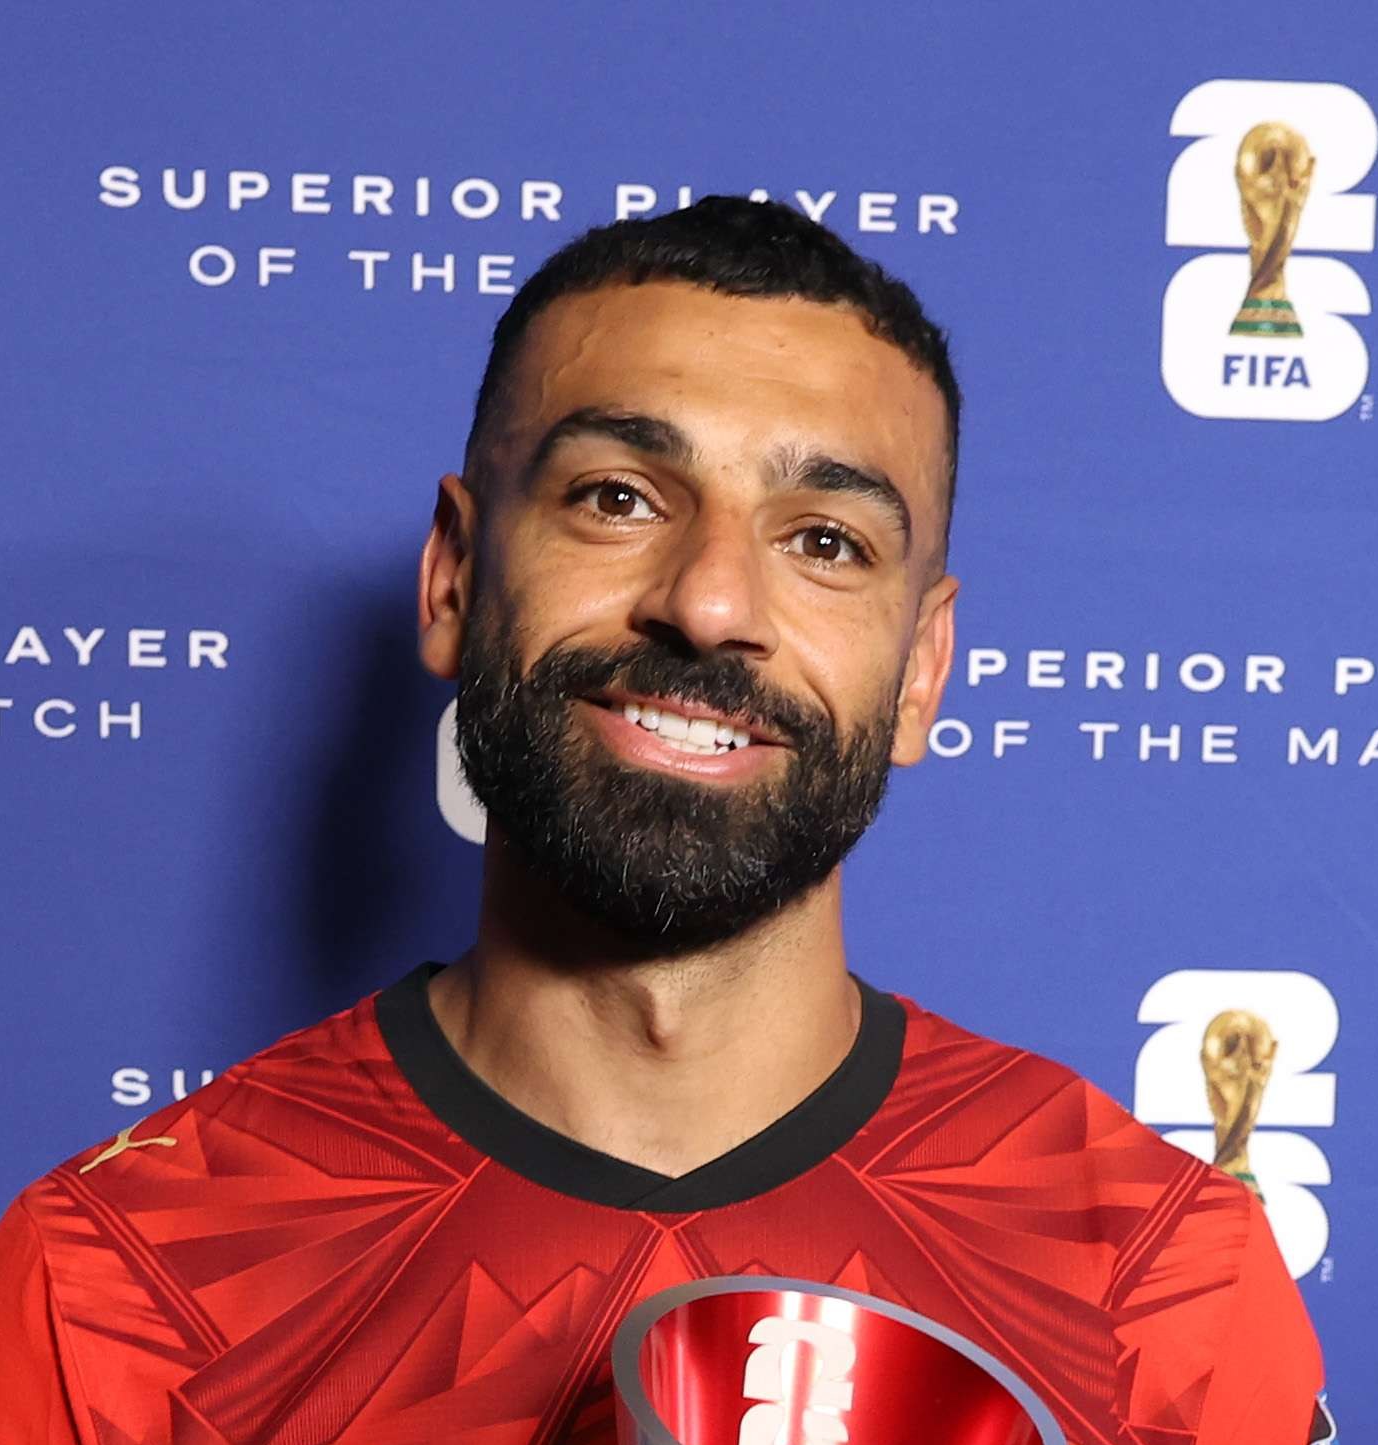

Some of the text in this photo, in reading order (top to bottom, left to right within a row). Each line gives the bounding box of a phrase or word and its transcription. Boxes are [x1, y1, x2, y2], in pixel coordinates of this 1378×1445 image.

[98, 165, 959, 235] SUPERIOR PYER
[188, 244, 516, 295] OF THE
[1223, 354, 1311, 388] FIFA
[967, 648, 1286, 694] PERIOR
[928, 718, 1031, 759] OF
[1078, 722, 1238, 764] THE
